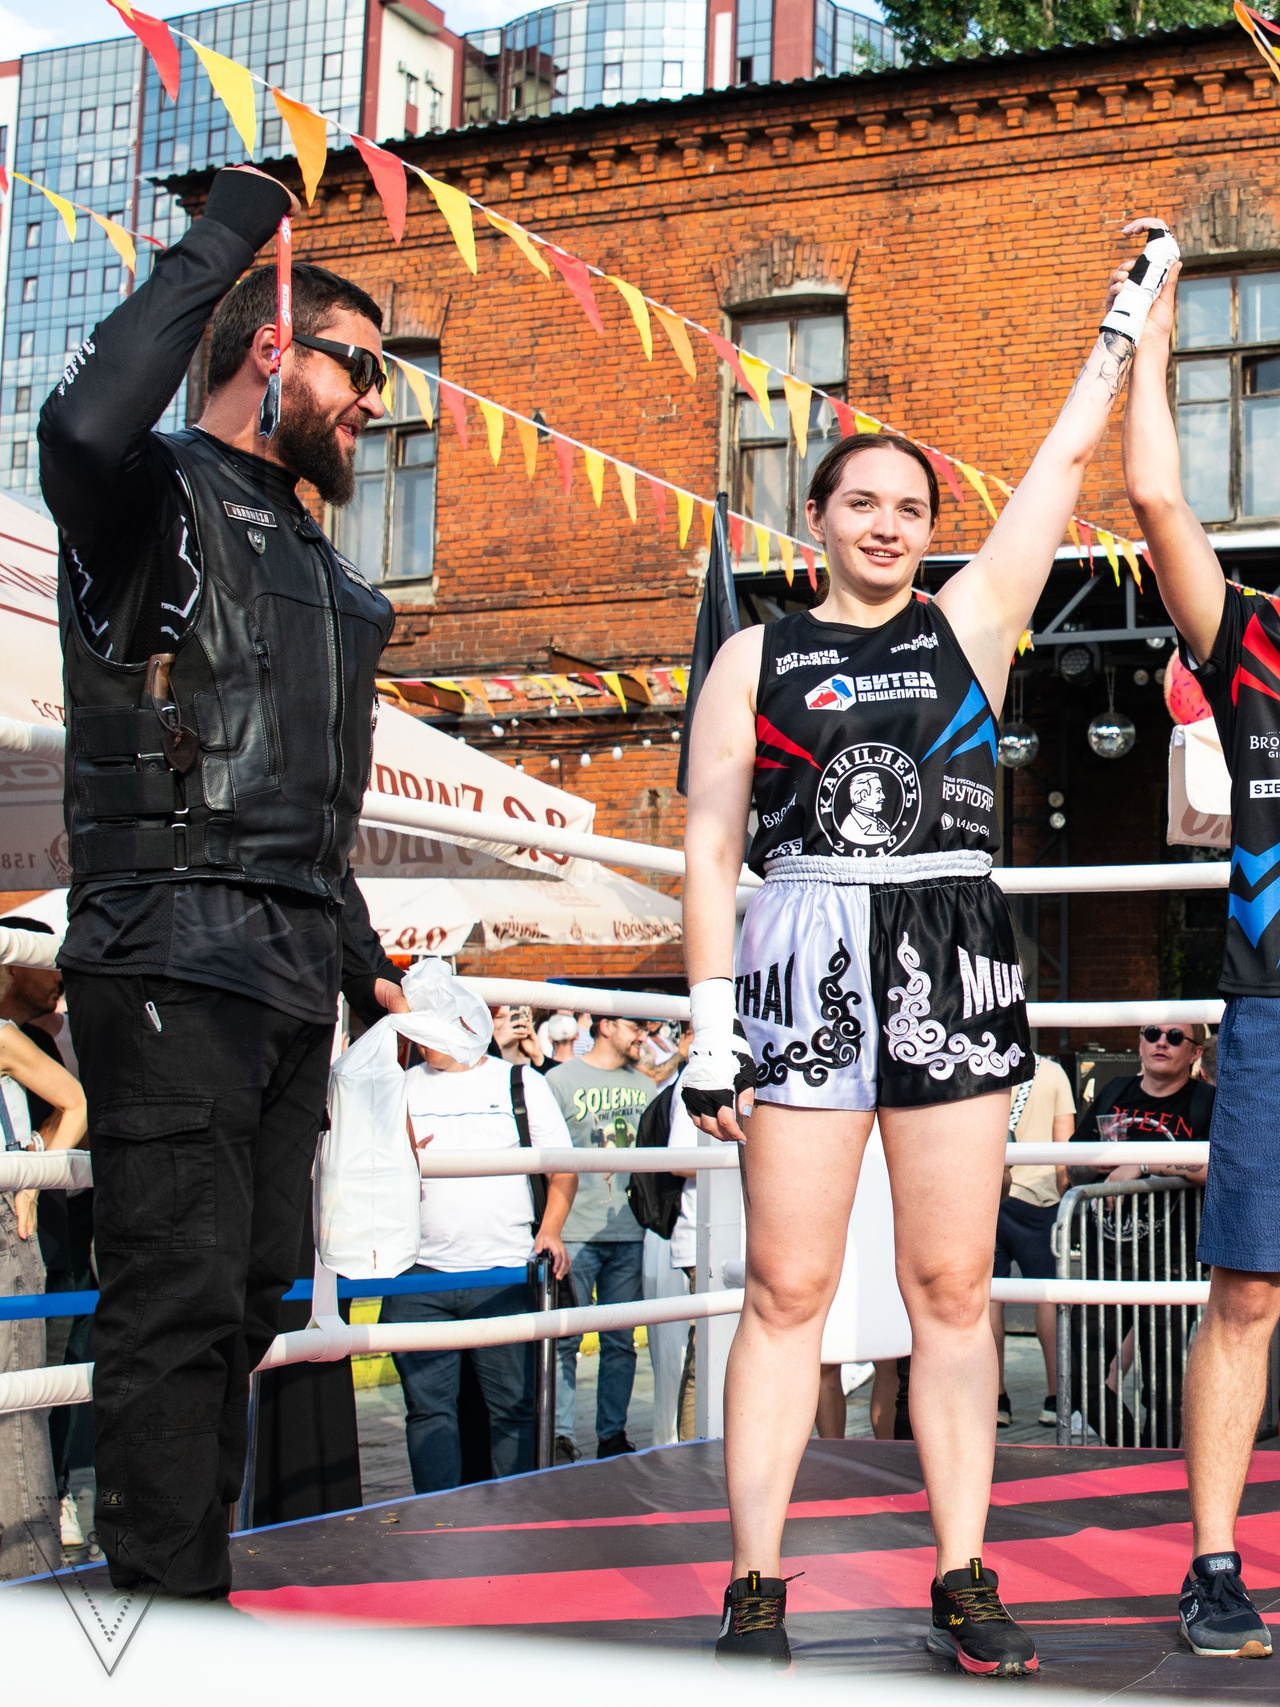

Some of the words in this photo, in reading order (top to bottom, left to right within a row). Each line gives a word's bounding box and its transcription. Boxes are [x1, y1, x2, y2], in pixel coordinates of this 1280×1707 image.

[776, 649, 838, 667] ТАТЬЯНА
[855, 671, 936, 692] БИТВА
[858, 688, 938, 702] ОБЩЕПИТОВ
[820, 747, 917, 815] КАНЦЛЕРЪ
[735, 952, 795, 1028] THAI
[957, 946, 1026, 1019] MUA
[573, 1087, 648, 1121] SOLENYA
[1103, 1105, 1193, 1140] QUEEN
